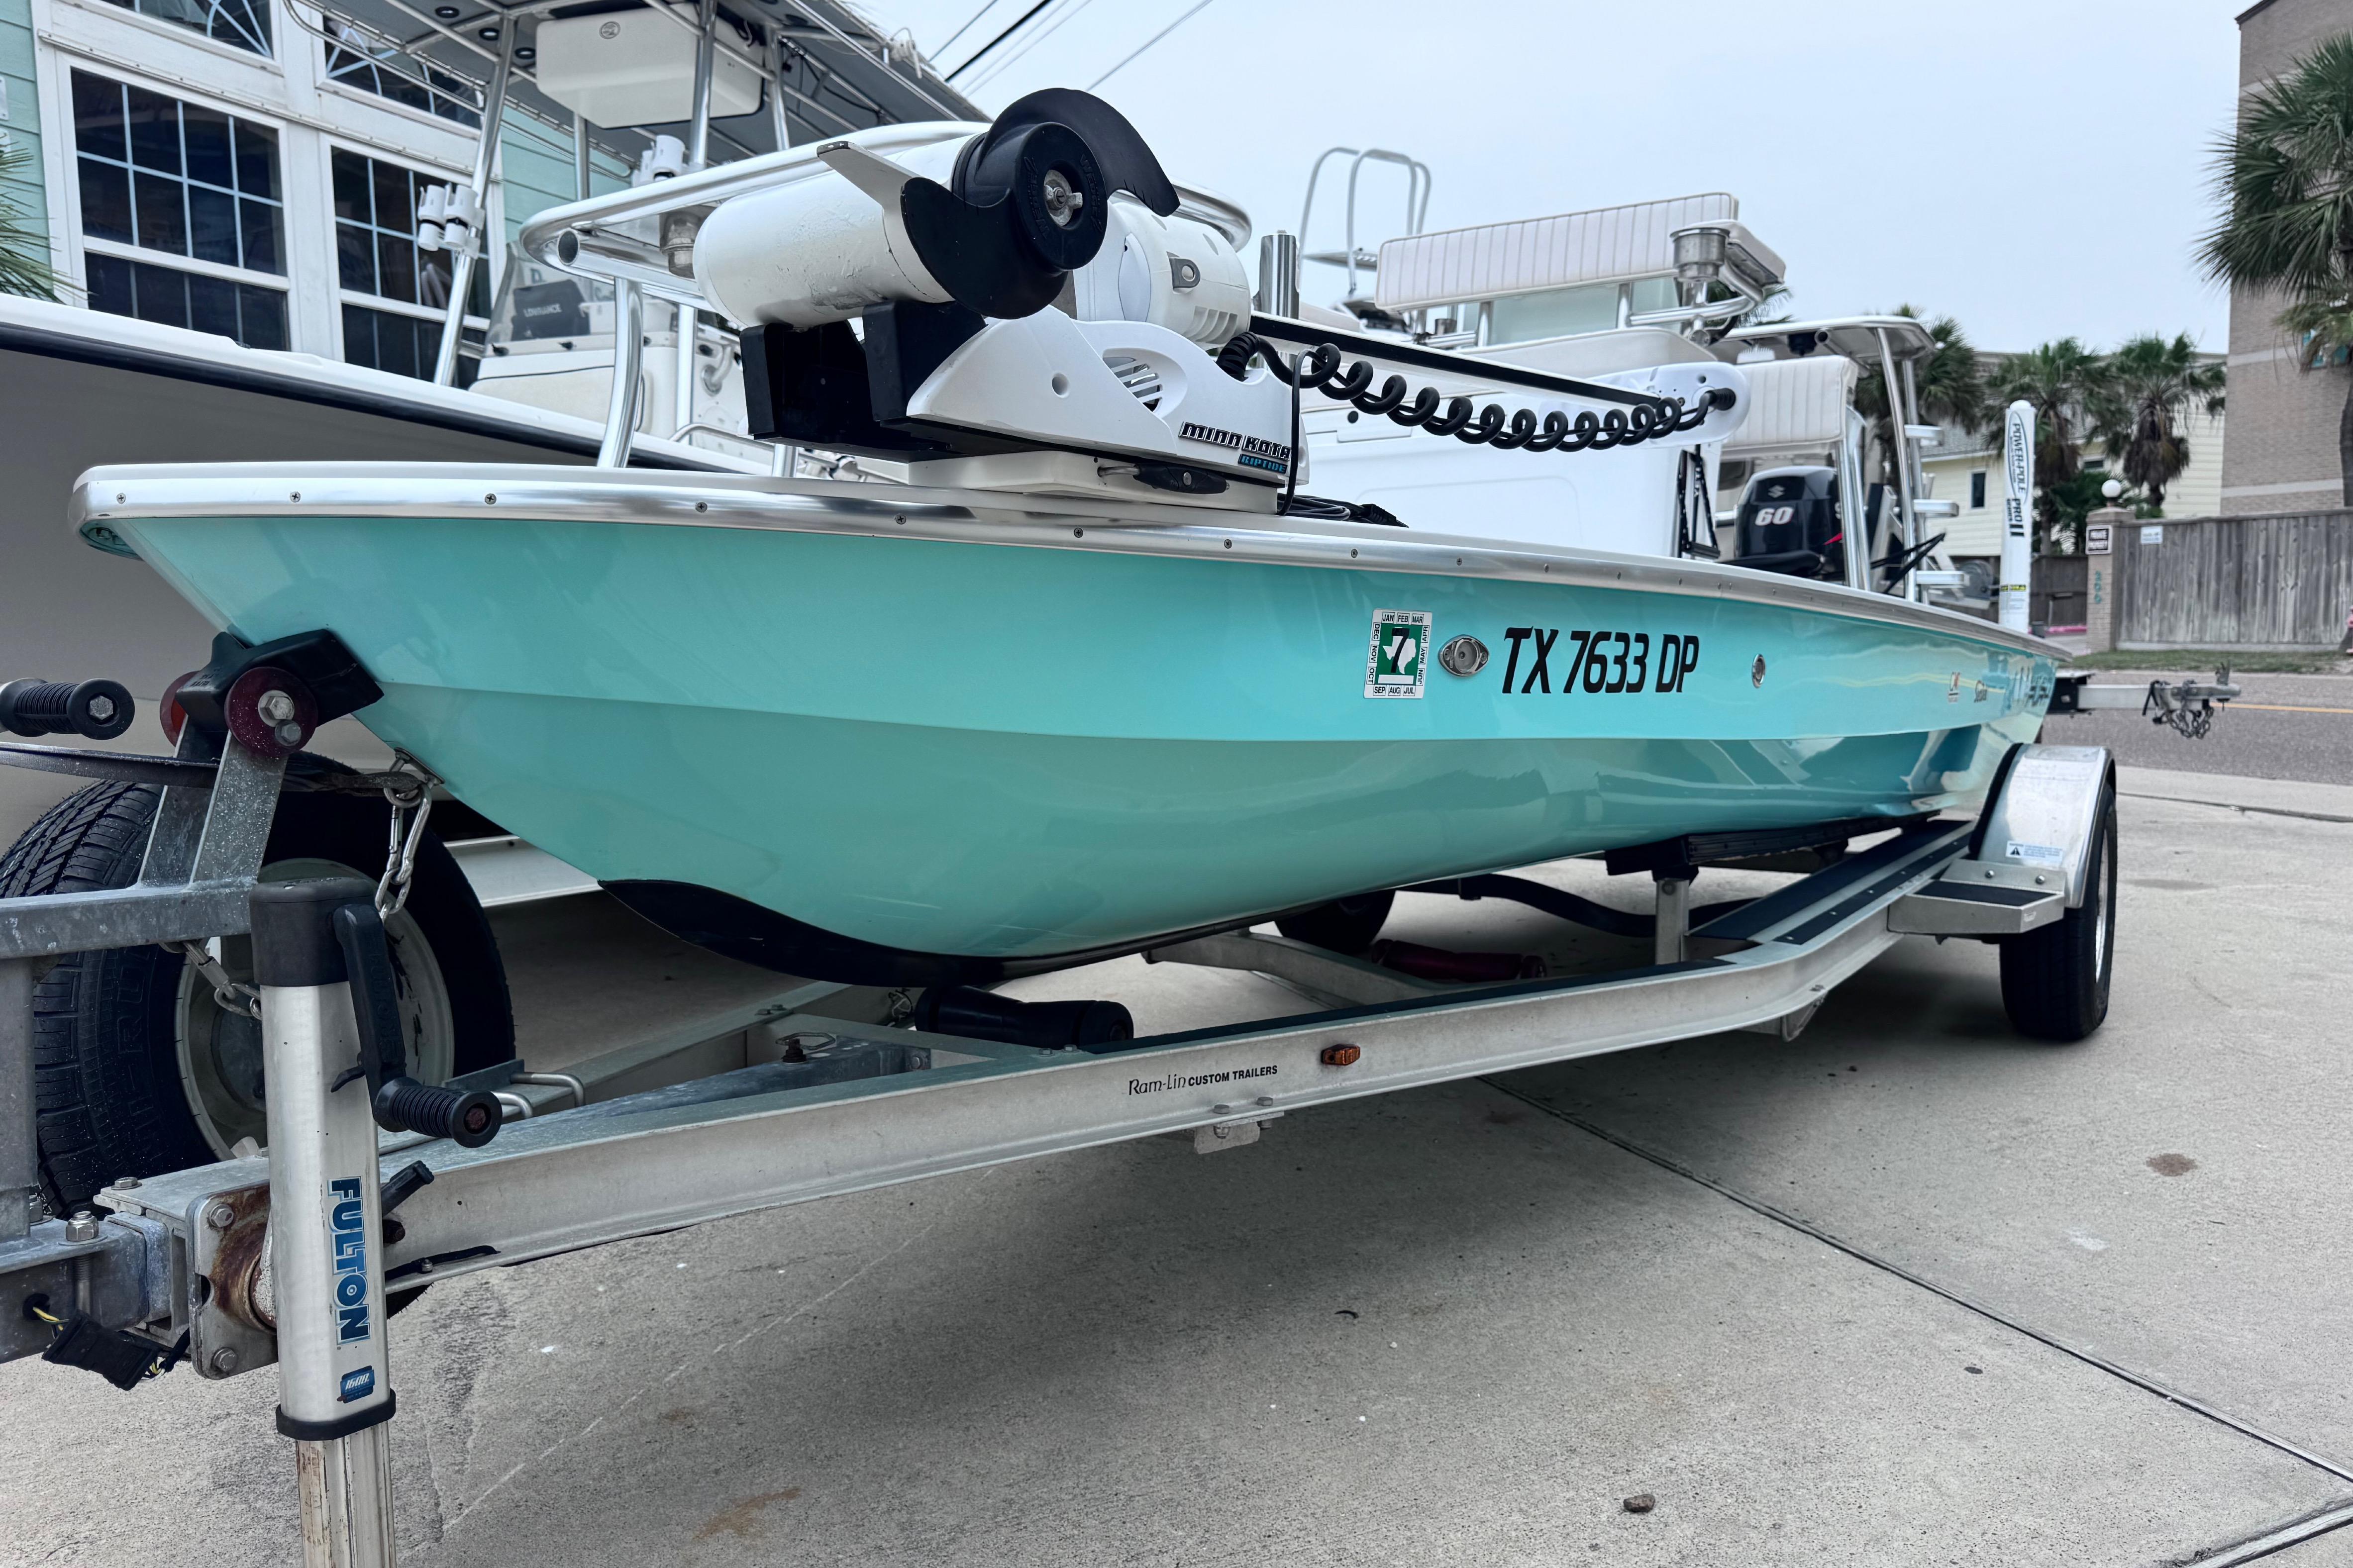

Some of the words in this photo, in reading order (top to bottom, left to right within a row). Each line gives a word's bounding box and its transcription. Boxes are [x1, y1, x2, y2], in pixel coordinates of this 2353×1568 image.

[523, 303, 562, 317] LOWRANCE
[1241, 435, 1292, 461] KOTA
[2013, 422, 2026, 493] POWER-POLE
[1239, 455, 1288, 474] RIPTIDE
[1755, 505, 1795, 526] 60
[2014, 497, 2023, 522] PRO
[1391, 627, 1410, 673] 7
[1502, 626, 1559, 694] TX
[1563, 630, 1649, 694] 7633
[1655, 634, 1700, 693] DP
[1128, 1074, 1186, 1095] Ram-Lin
[1188, 1072, 1230, 1086] CUSTOM
[1232, 1065, 1278, 1080] TRAILERS
[327, 1176, 371, 1345] FULTON
